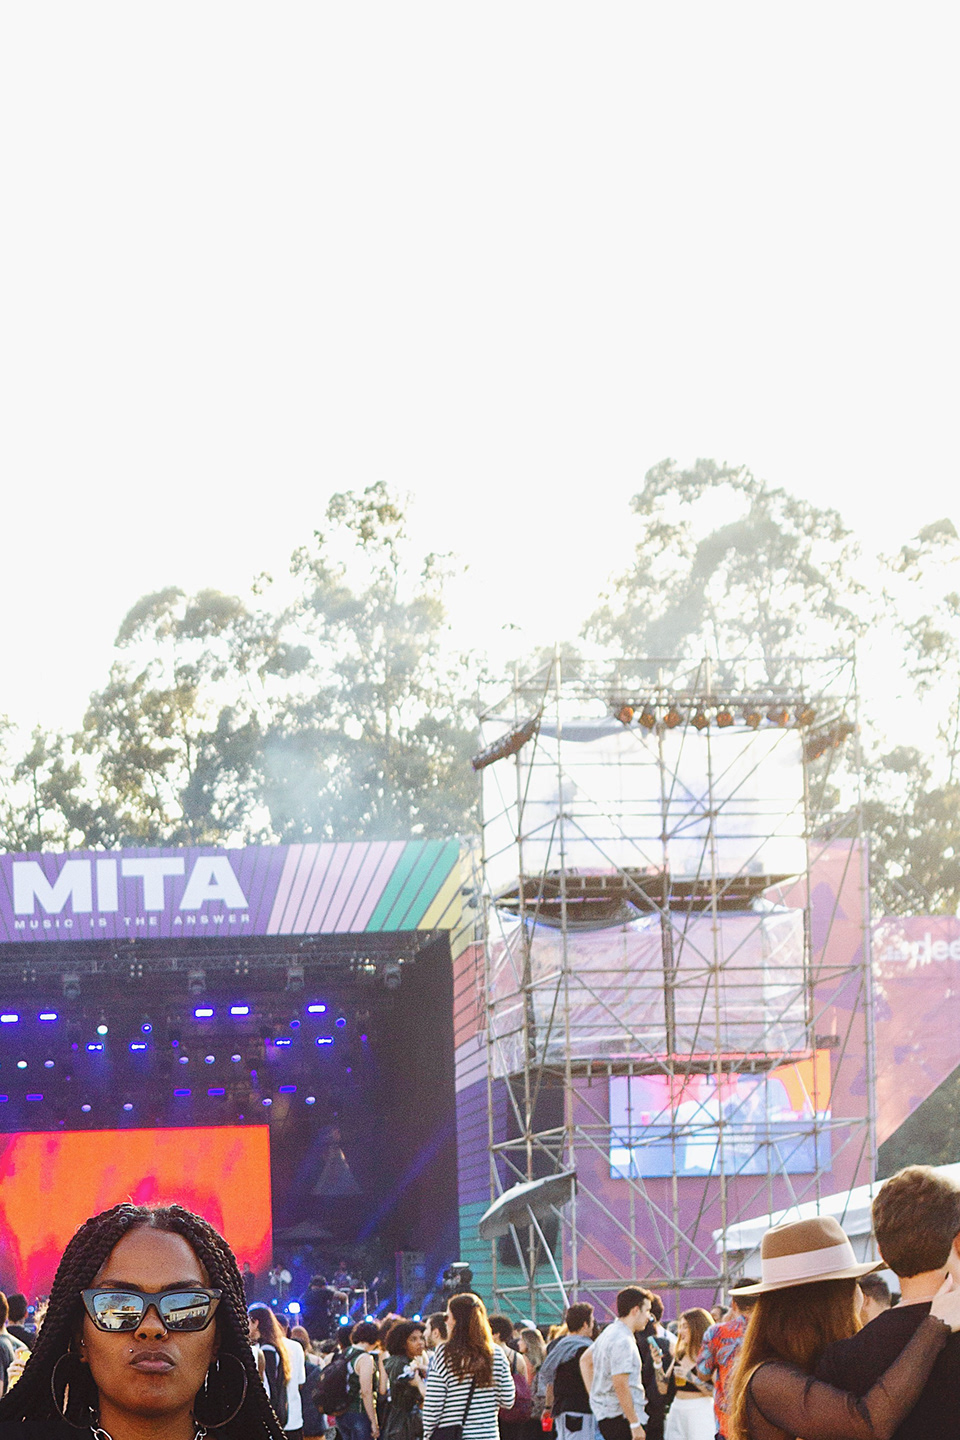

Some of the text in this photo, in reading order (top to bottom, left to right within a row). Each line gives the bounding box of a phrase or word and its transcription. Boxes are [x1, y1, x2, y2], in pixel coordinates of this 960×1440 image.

[12, 856, 249, 915] MITA
[14, 913, 251, 929] MUSIC IS THE ANSWER
